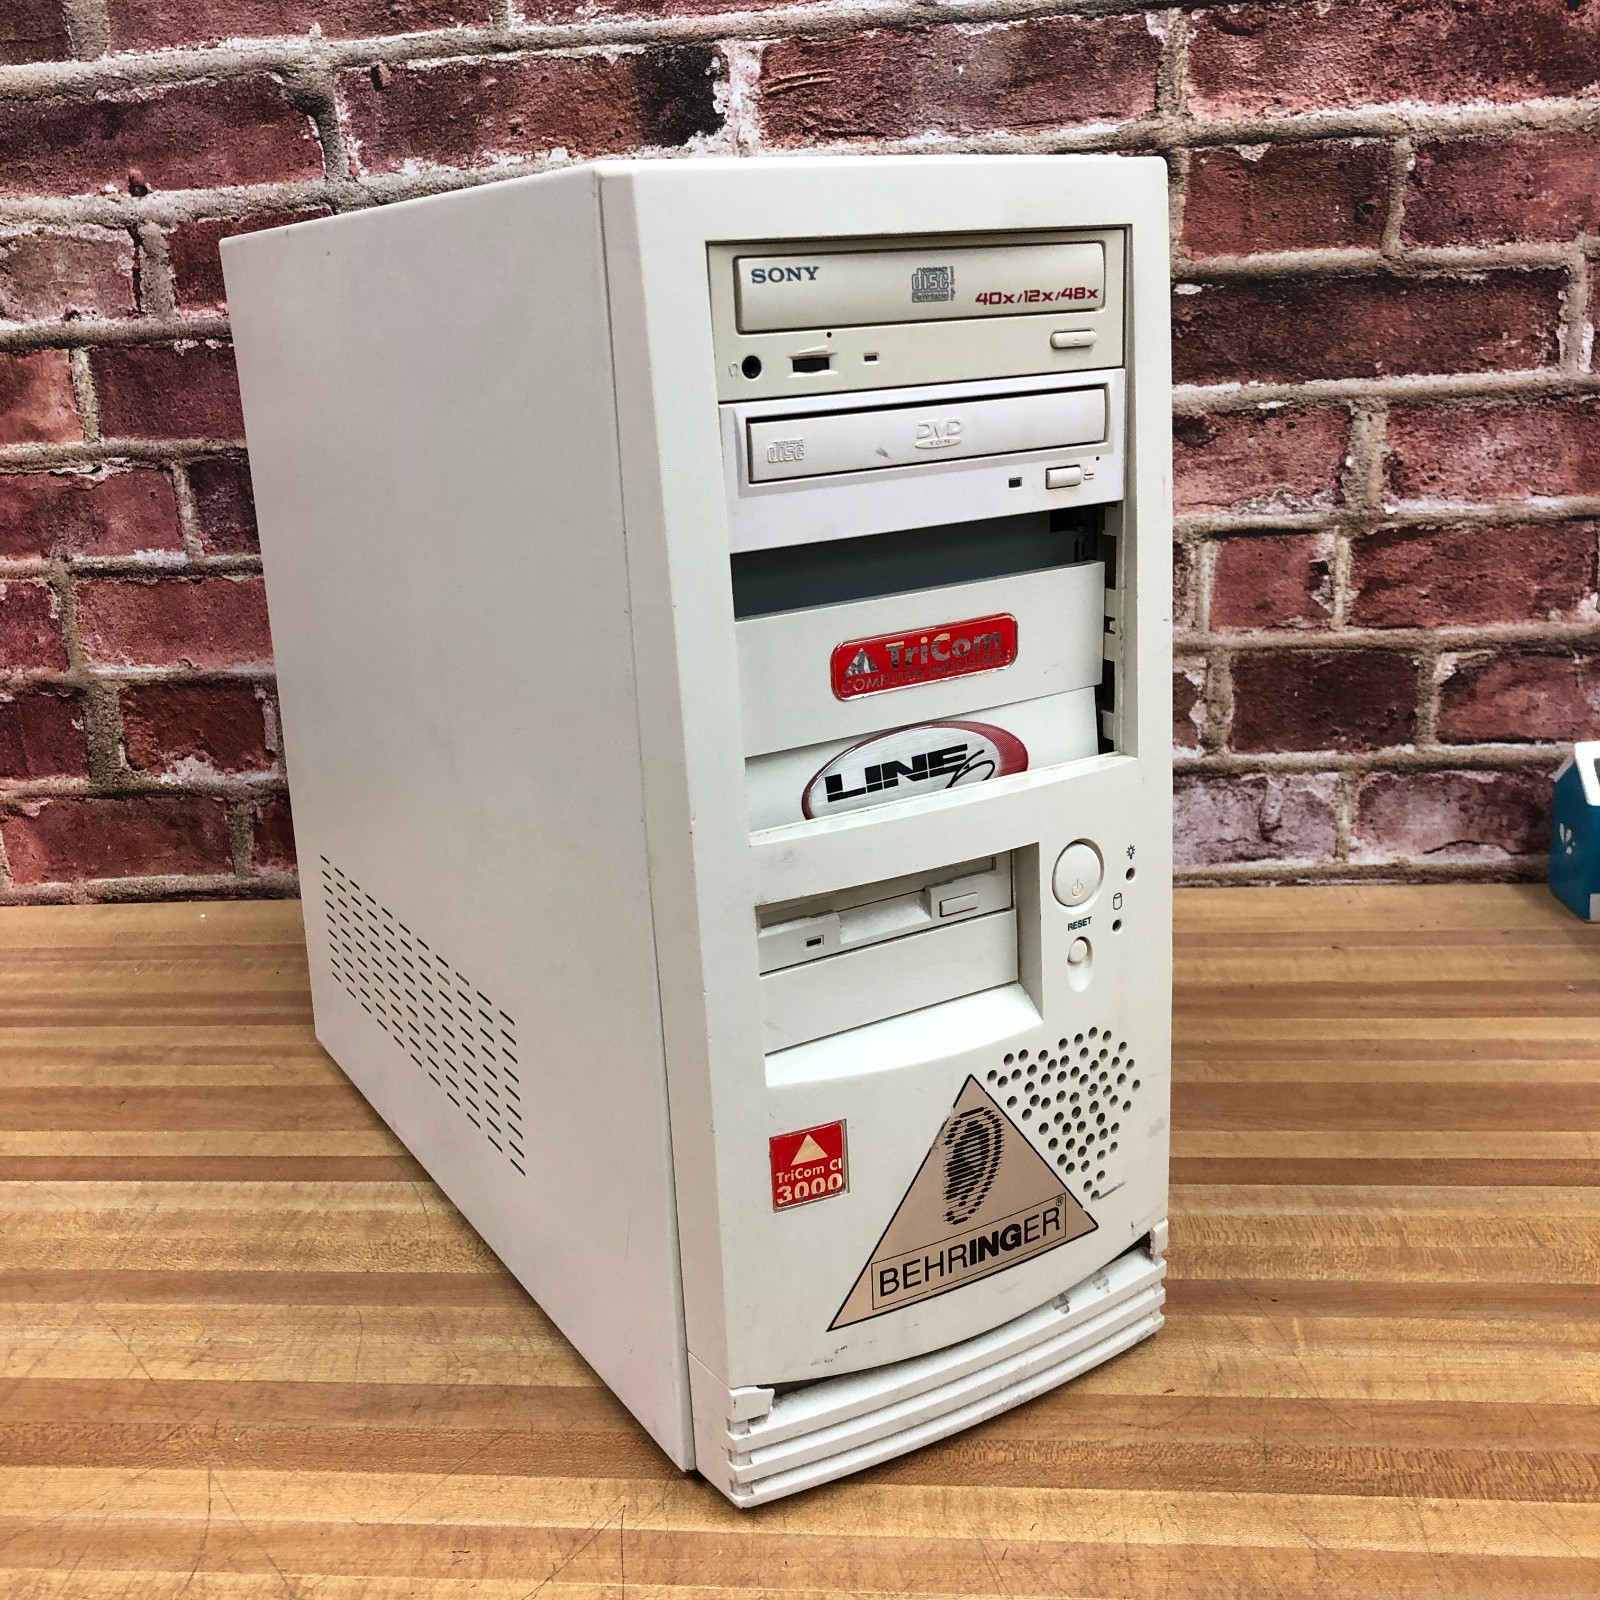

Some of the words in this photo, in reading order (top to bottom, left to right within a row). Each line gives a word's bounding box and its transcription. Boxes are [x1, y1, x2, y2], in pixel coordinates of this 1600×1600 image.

[751, 266, 820, 285] SONY
[975, 286, 1099, 305] 40x/12x/48x
[916, 418, 963, 439] DVD
[885, 631, 1002, 669] TriCom
[840, 667, 925, 694] COMPUTER
[825, 743, 968, 803] LINE
[1067, 915, 1092, 931] RESET
[776, 1165, 825, 1184] TriCom
[776, 1172, 843, 1205] 3000
